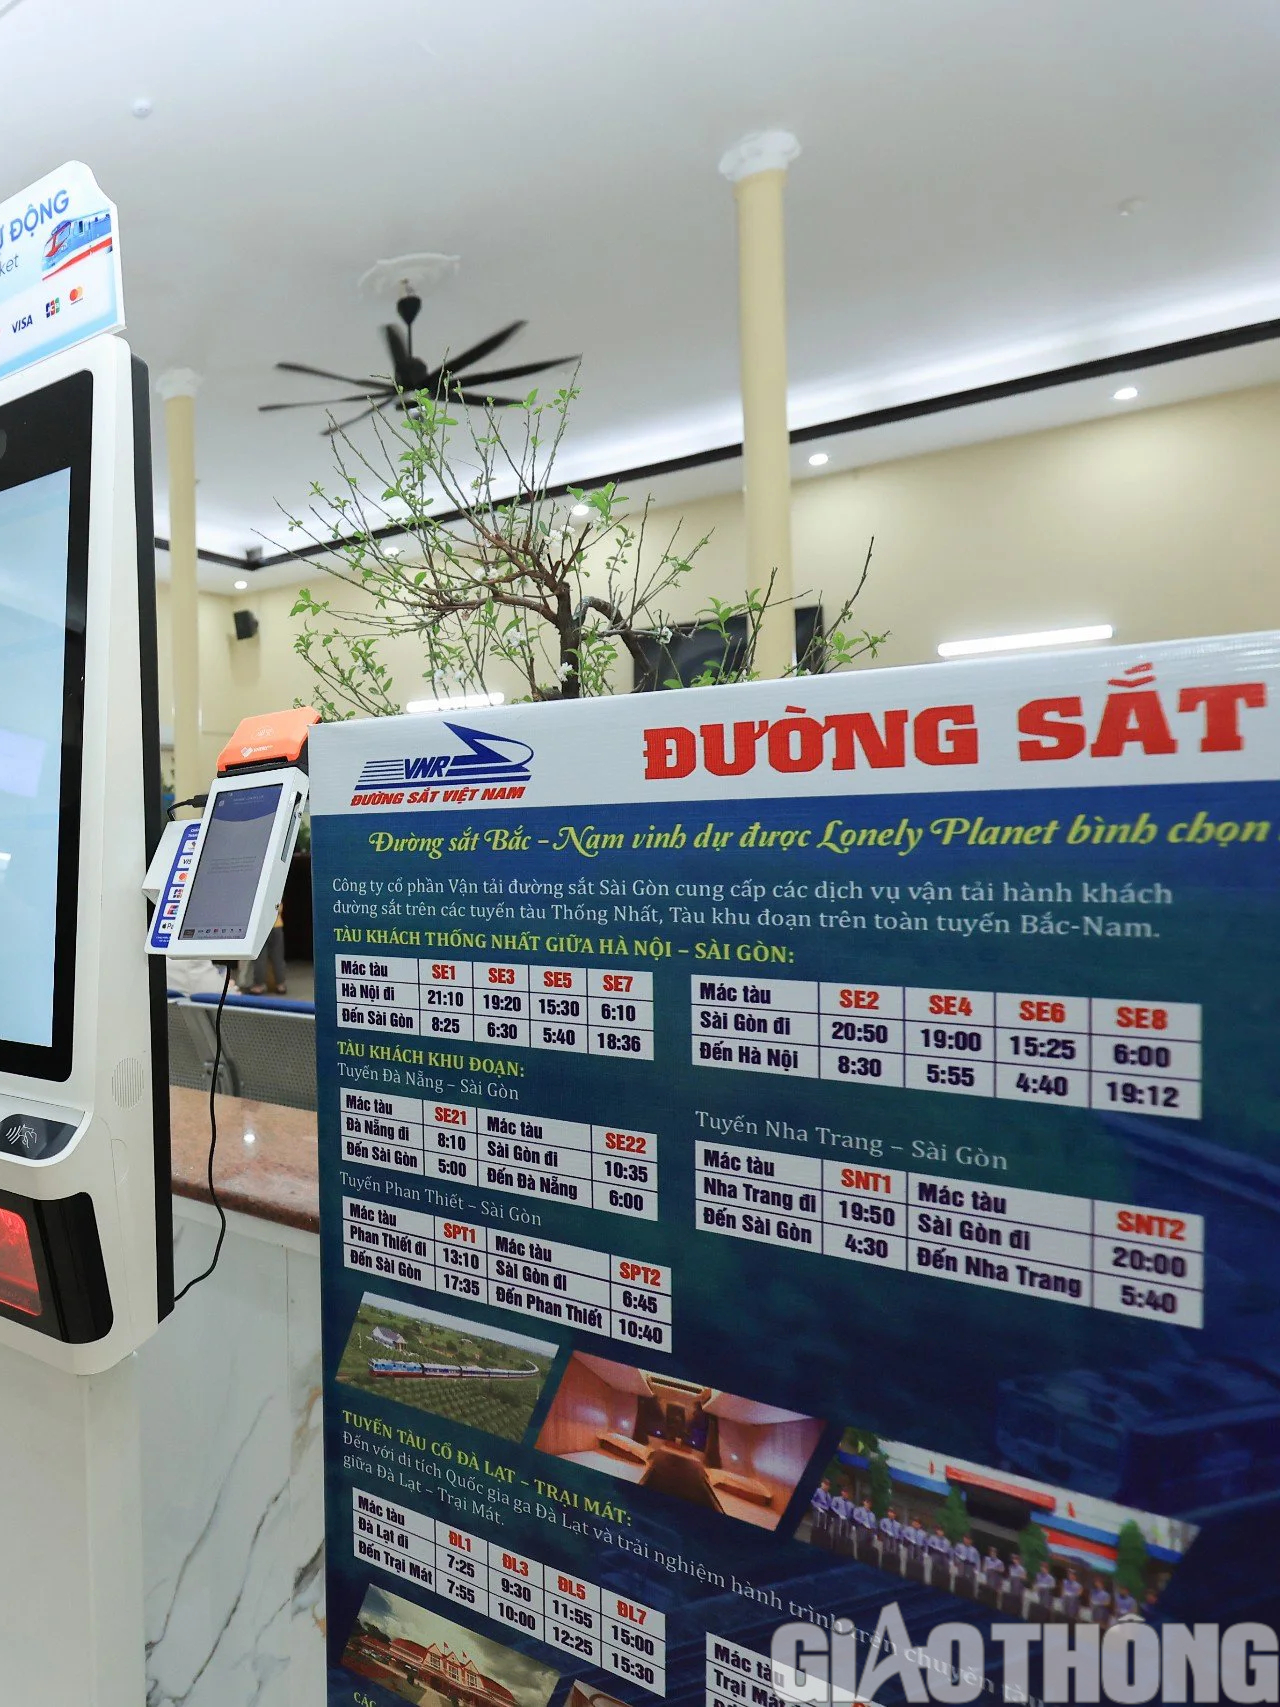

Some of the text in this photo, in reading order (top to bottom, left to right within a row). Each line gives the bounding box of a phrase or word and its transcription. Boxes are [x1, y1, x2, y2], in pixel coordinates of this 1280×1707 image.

[10, 190, 69, 242] ĐỘNG
[12, 315, 33, 333] VISA
[643, 662, 1267, 780] ĐƯỜNG SẮT
[402, 755, 451, 780] VNR
[351, 785, 526, 807] ĐƯỜNG SẮT VIỆT NAM
[368, 811, 1271, 859] Đường sắt Bắc Nam vinh dự được Lonely Planet bình chọn
[334, 926, 795, 964] TÀU KHÁCH THỐNG NHẤT GIỮA HÀ NỘI SÀI GÒN:
[341, 960, 388, 978] Mác tàu
[432, 964, 456, 980] SE1
[488, 968, 515, 985] SE3
[543, 971, 572, 988] SE5
[341, 983, 395, 1003] Hà Nội đi
[603, 975, 633, 993] SE7
[427, 989, 464, 1007] 21:10
[483, 993, 522, 1012] 19:20
[538, 998, 580, 1018] 15:30
[839, 989, 880, 1010] SE2
[928, 995, 972, 1016] SE4
[601, 1003, 636, 1022] 6:10
[1019, 1000, 1066, 1024] SE6
[1116, 1006, 1168, 1030] SE8
[337, 1041, 525, 1078] TÀU KHÁCH KHU ĐOẠN:
[699, 1040, 799, 1072] Đến Hà Nội
[837, 1055, 882, 1077] 8:30
[337, 1062, 444, 1093] Tuyến Đà Nẵng
[926, 1063, 975, 1087] 5:55
[1016, 1072, 1069, 1096] 4:40
[1106, 1081, 1180, 1108] 19:12
[434, 1106, 467, 1126] SE21
[605, 1132, 647, 1155] SE22
[765, 1120, 884, 1158] Nha Trang
[604, 1160, 648, 1183] 10:35
[841, 1167, 892, 1194] SNT1
[443, 1222, 476, 1244] SPT1
[1116, 1209, 1186, 1241] SNT2
[619, 1261, 661, 1287] SPT2
[526, 1290, 602, 1329] Phan Thiết
[1121, 1284, 1178, 1315] 5:40
[618, 1318, 663, 1345] 10:40
[343, 1410, 633, 1527] TUYẾN TÀU CỔ ĐÀ LẠT TRẠI MÁT:
[448, 1530, 472, 1552] ĐL1
[502, 1553, 529, 1577] ĐL3
[446, 1578, 476, 1604] 7:55
[558, 1575, 586, 1600] ĐL5
[497, 1602, 536, 1631] 10:00
[617, 1600, 647, 1626] ĐL7
[553, 1625, 593, 1656] 12:25
[610, 1652, 655, 1685] 15:30
